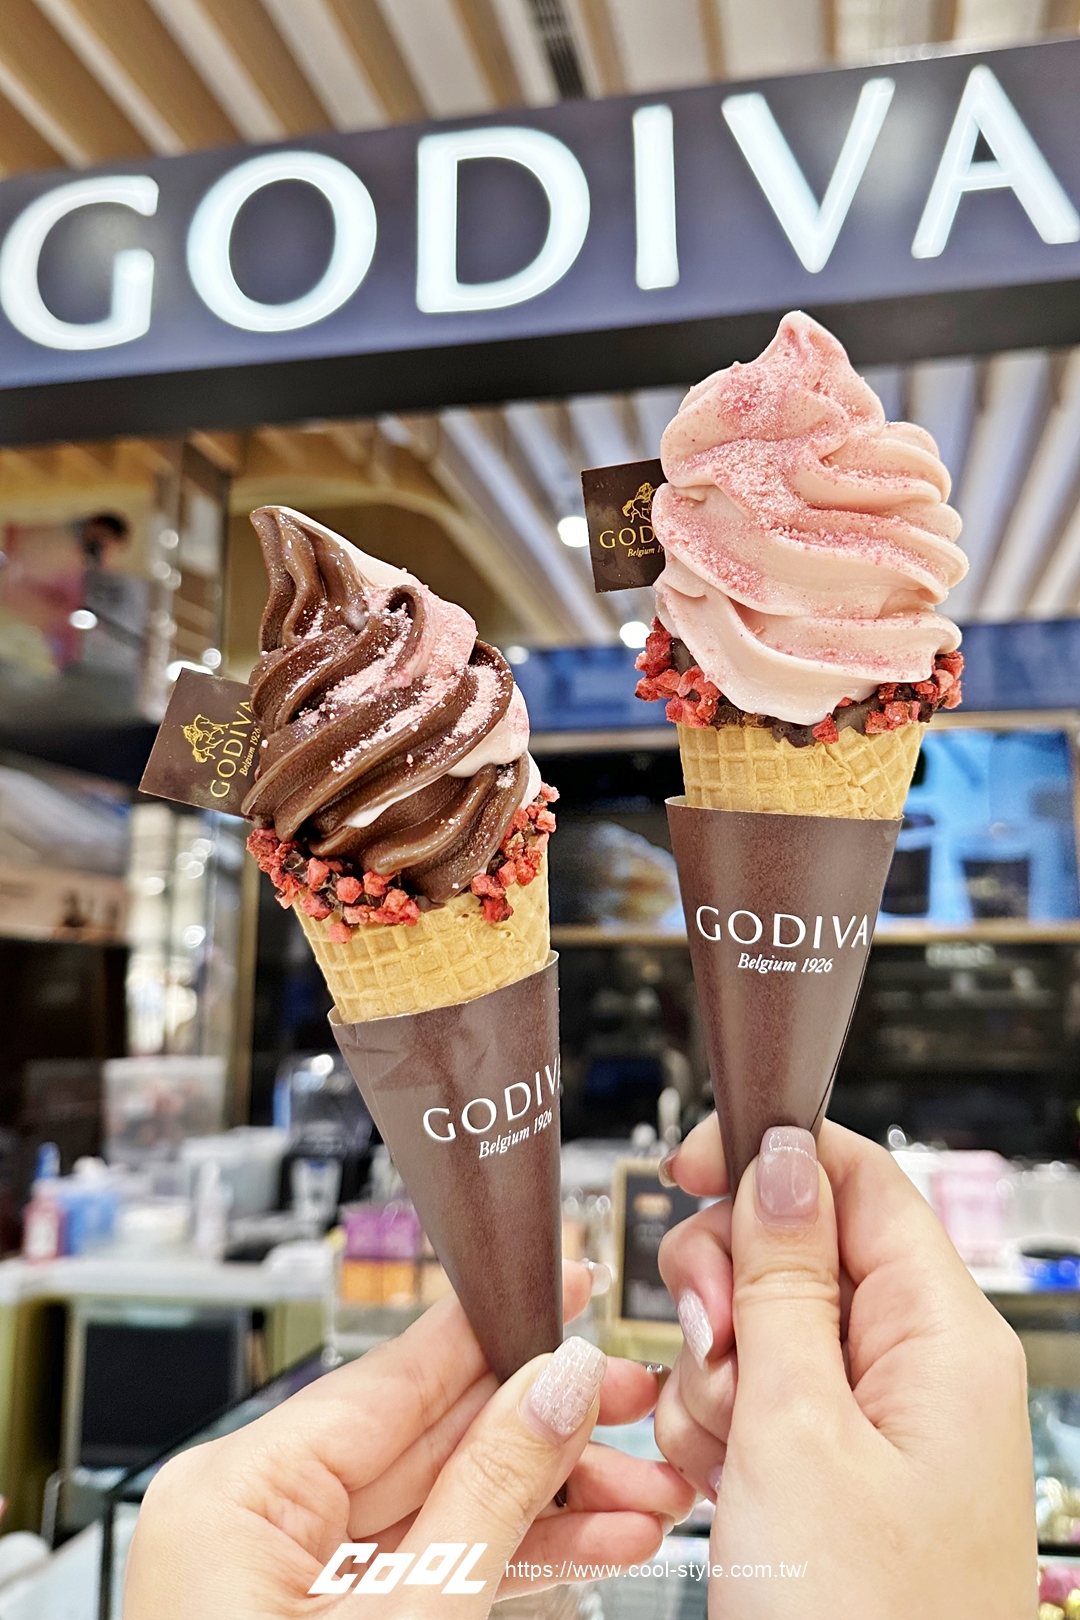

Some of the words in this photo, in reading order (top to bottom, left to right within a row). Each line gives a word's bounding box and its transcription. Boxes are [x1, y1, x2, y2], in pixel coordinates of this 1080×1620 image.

[0, 65, 1080, 351] GODIVA
[599, 525, 655, 548] GOD
[627, 547, 655, 557] Belgium
[239, 746, 255, 776] Belgium
[696, 905, 868, 949] GODIVA
[738, 952, 797, 974] Belgium
[801, 957, 834, 973] 1926
[479, 1126, 530, 1159] Belgium
[533, 1108, 553, 1135] 1926
